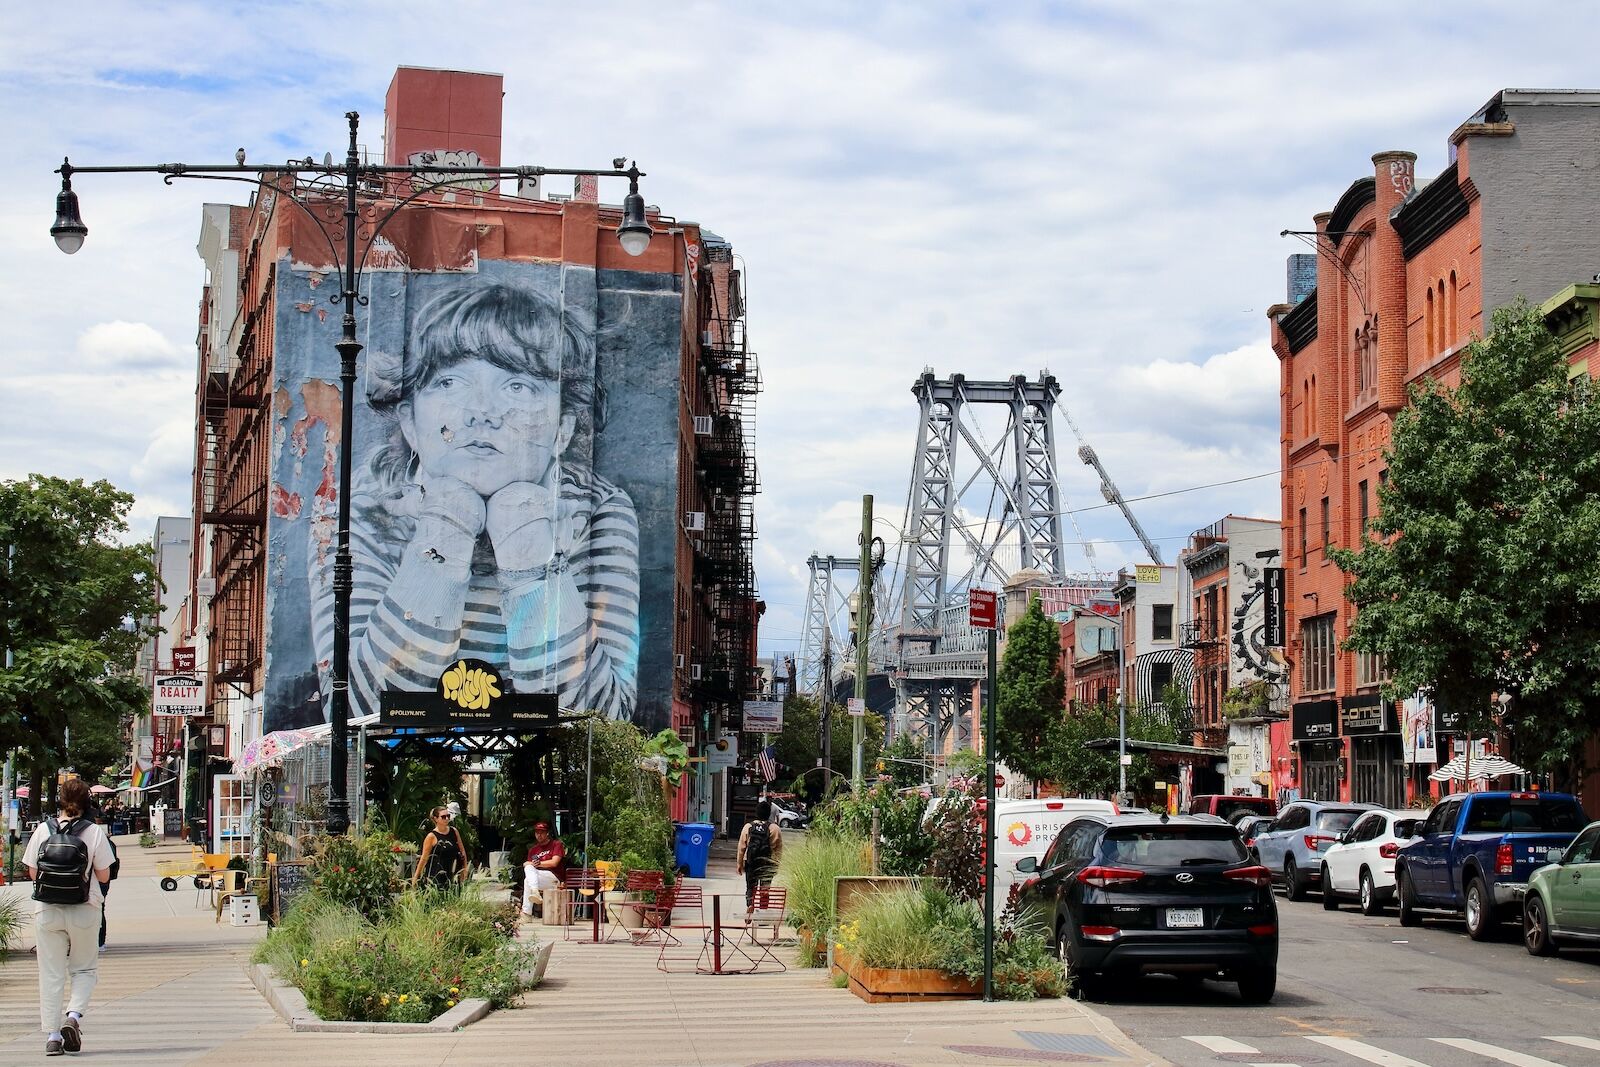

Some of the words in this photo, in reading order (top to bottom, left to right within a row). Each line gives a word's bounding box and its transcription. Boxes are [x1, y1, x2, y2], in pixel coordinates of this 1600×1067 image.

[977, 593, 993, 602] STANDING
[161, 687, 198, 697] REALTY
[390, 709, 426, 717] @POLLYN.NYC
